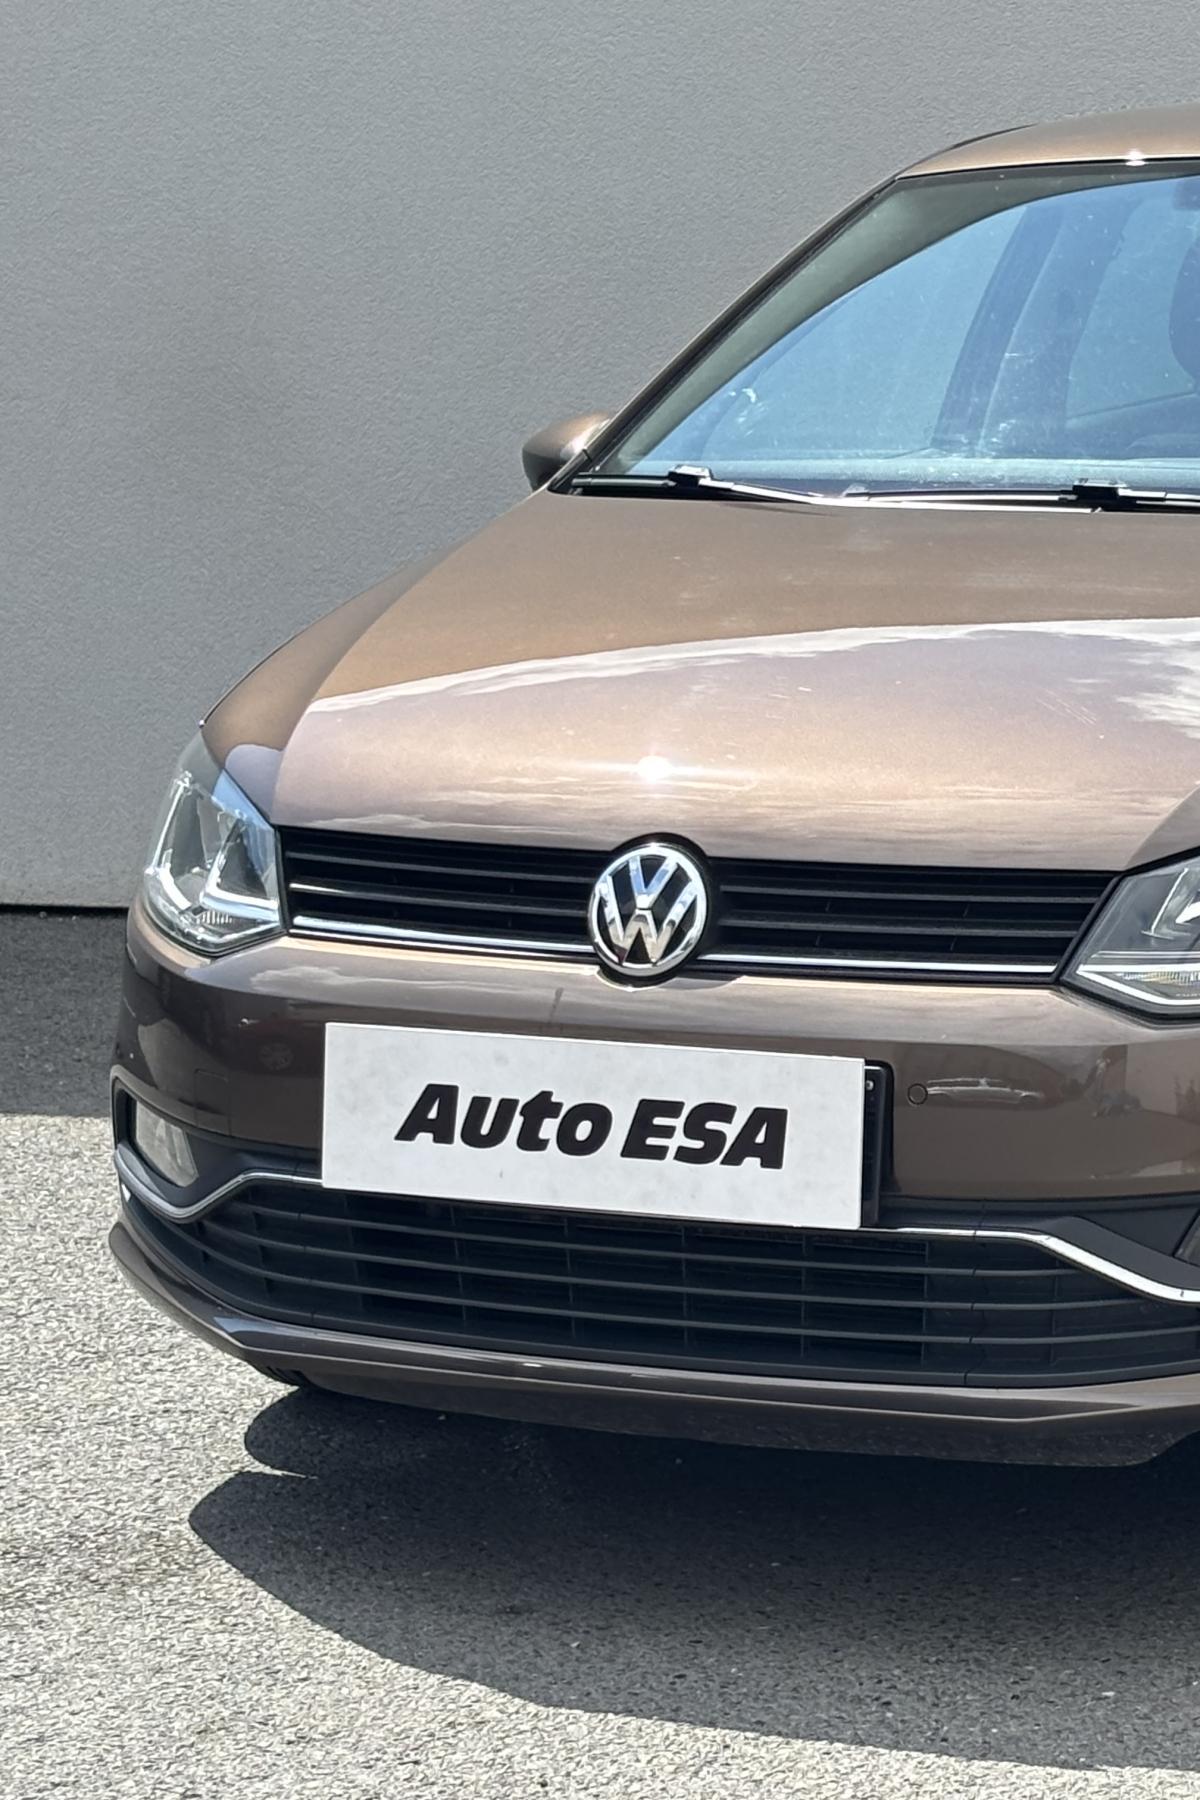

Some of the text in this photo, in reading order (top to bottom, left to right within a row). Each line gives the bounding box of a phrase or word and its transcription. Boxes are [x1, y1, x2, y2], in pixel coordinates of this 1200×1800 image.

[597, 854, 699, 965] VW
[394, 1083, 788, 1170] Auto ESA
